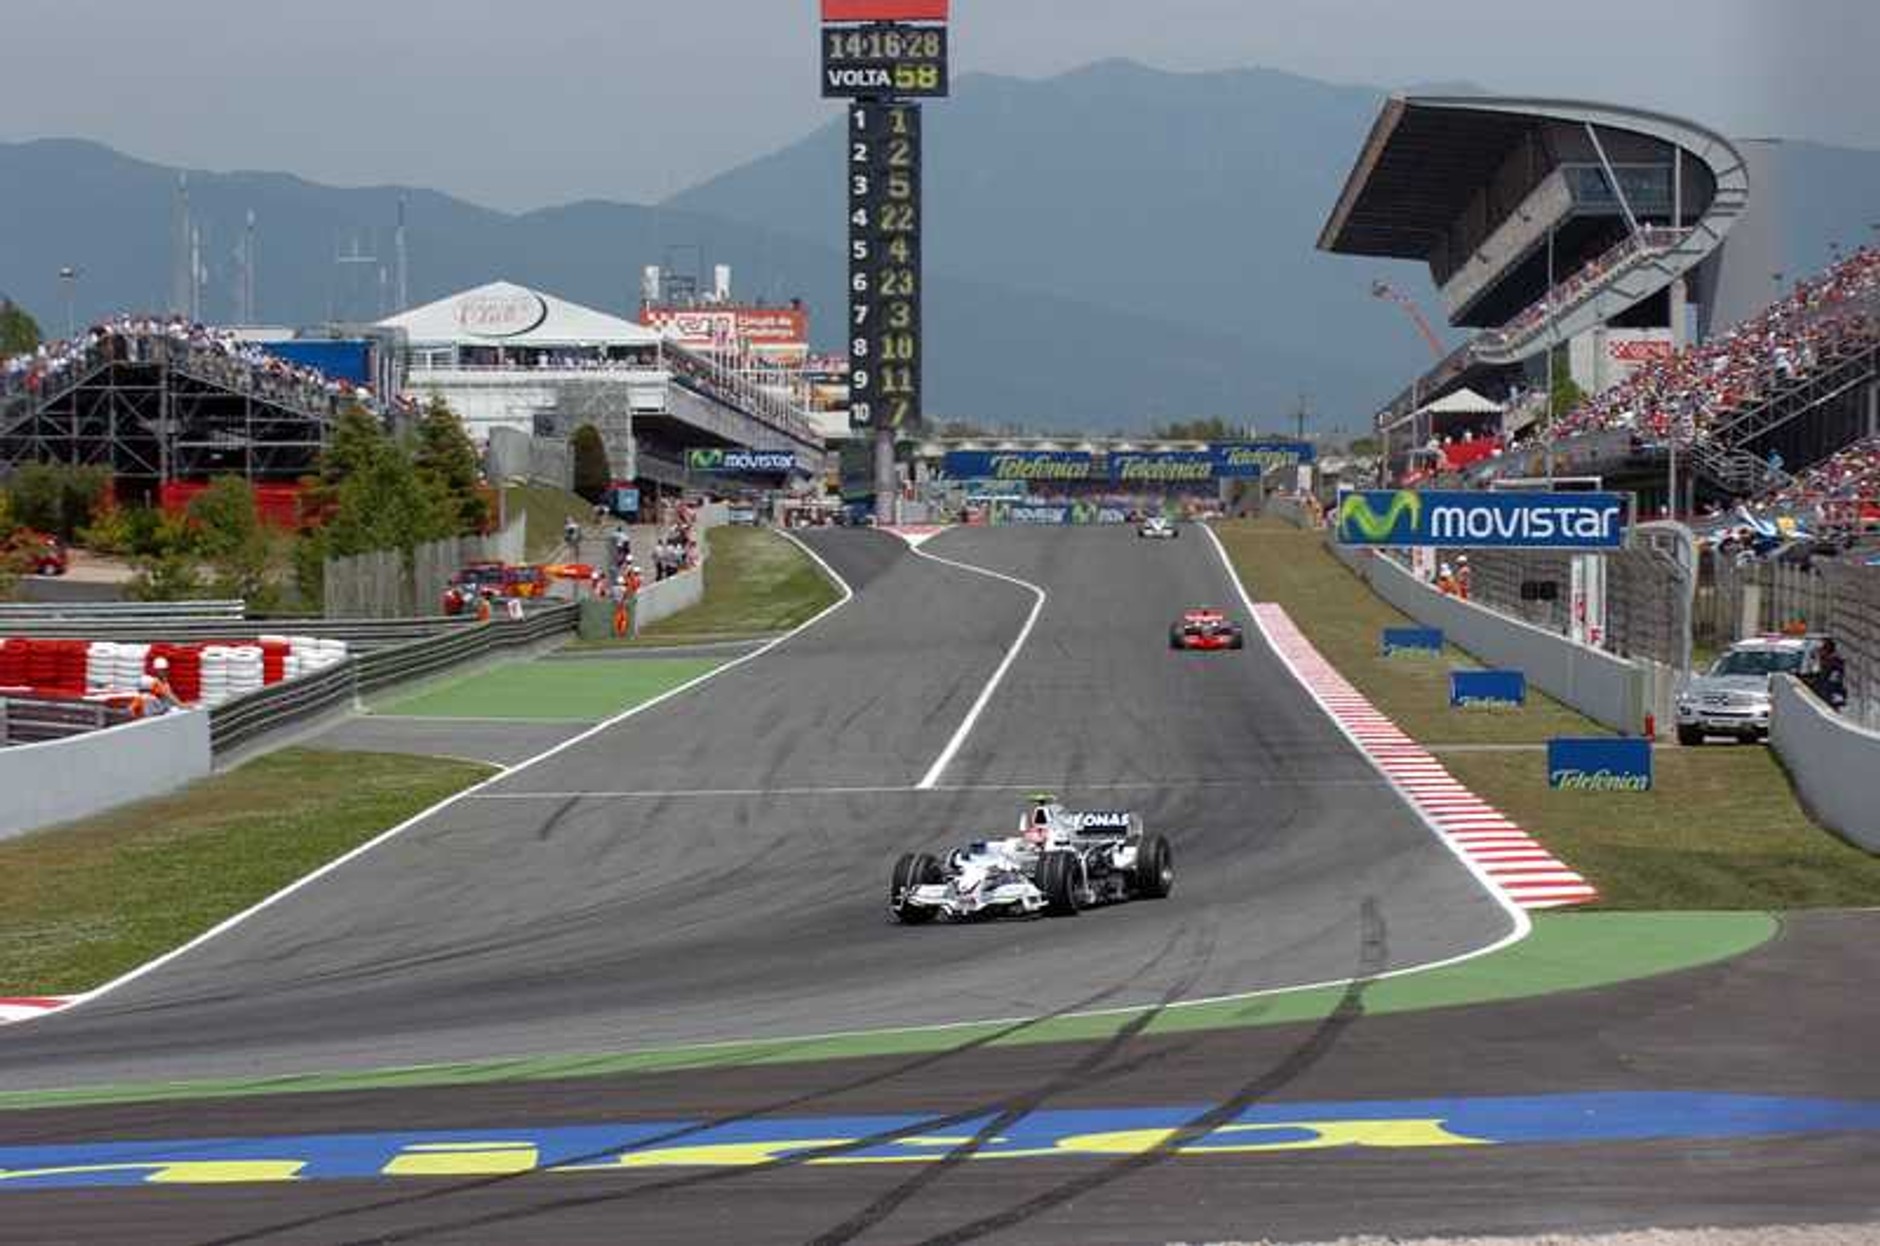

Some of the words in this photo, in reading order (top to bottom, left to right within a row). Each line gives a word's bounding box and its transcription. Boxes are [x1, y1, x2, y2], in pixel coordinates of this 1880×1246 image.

[828, 70, 891, 86] VOLTA
[895, 64, 938, 88] 58
[854, 110, 865, 129] 1
[853, 143, 867, 161] 2
[854, 176, 867, 194] 3
[853, 208, 868, 226] 4
[853, 240, 867, 259] 5
[853, 273, 867, 291] 6
[853, 305, 868, 324] 7
[853, 338, 868, 356] 8
[853, 371, 868, 389] 9
[851, 403, 870, 421] 10
[724, 453, 795, 470] movistar
[1431, 507, 1620, 538] movistar
